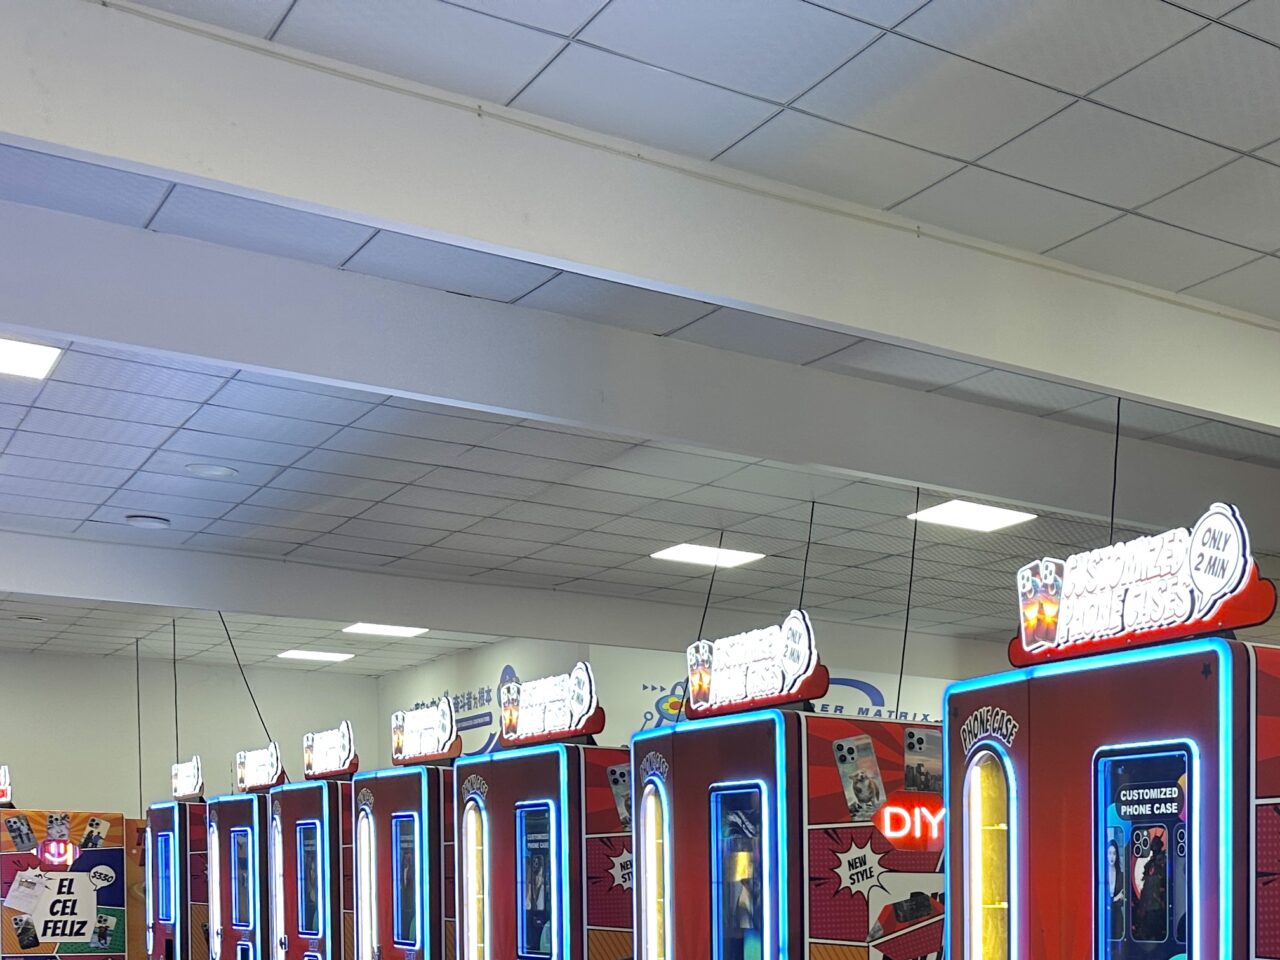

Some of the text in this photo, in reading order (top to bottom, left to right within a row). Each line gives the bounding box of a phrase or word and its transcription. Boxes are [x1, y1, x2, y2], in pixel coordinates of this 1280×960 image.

[1201, 528, 1231, 552] ONLY
[1194, 553, 1229, 579] 2 MIN
[858, 707, 930, 721] MATRIX
[961, 706, 1019, 754] PHONE CASE
[1120, 787, 1179, 800] CUSTOMIZED
[1121, 803, 1178, 815] PHONE CASE
[884, 807, 946, 838] DIY
[848, 854, 867, 871] NEW
[849, 867, 874, 886] STYLE
[57, 878, 74, 895] EL
[50, 899, 77, 916] CEL
[41, 920, 87, 936] FELIZ
